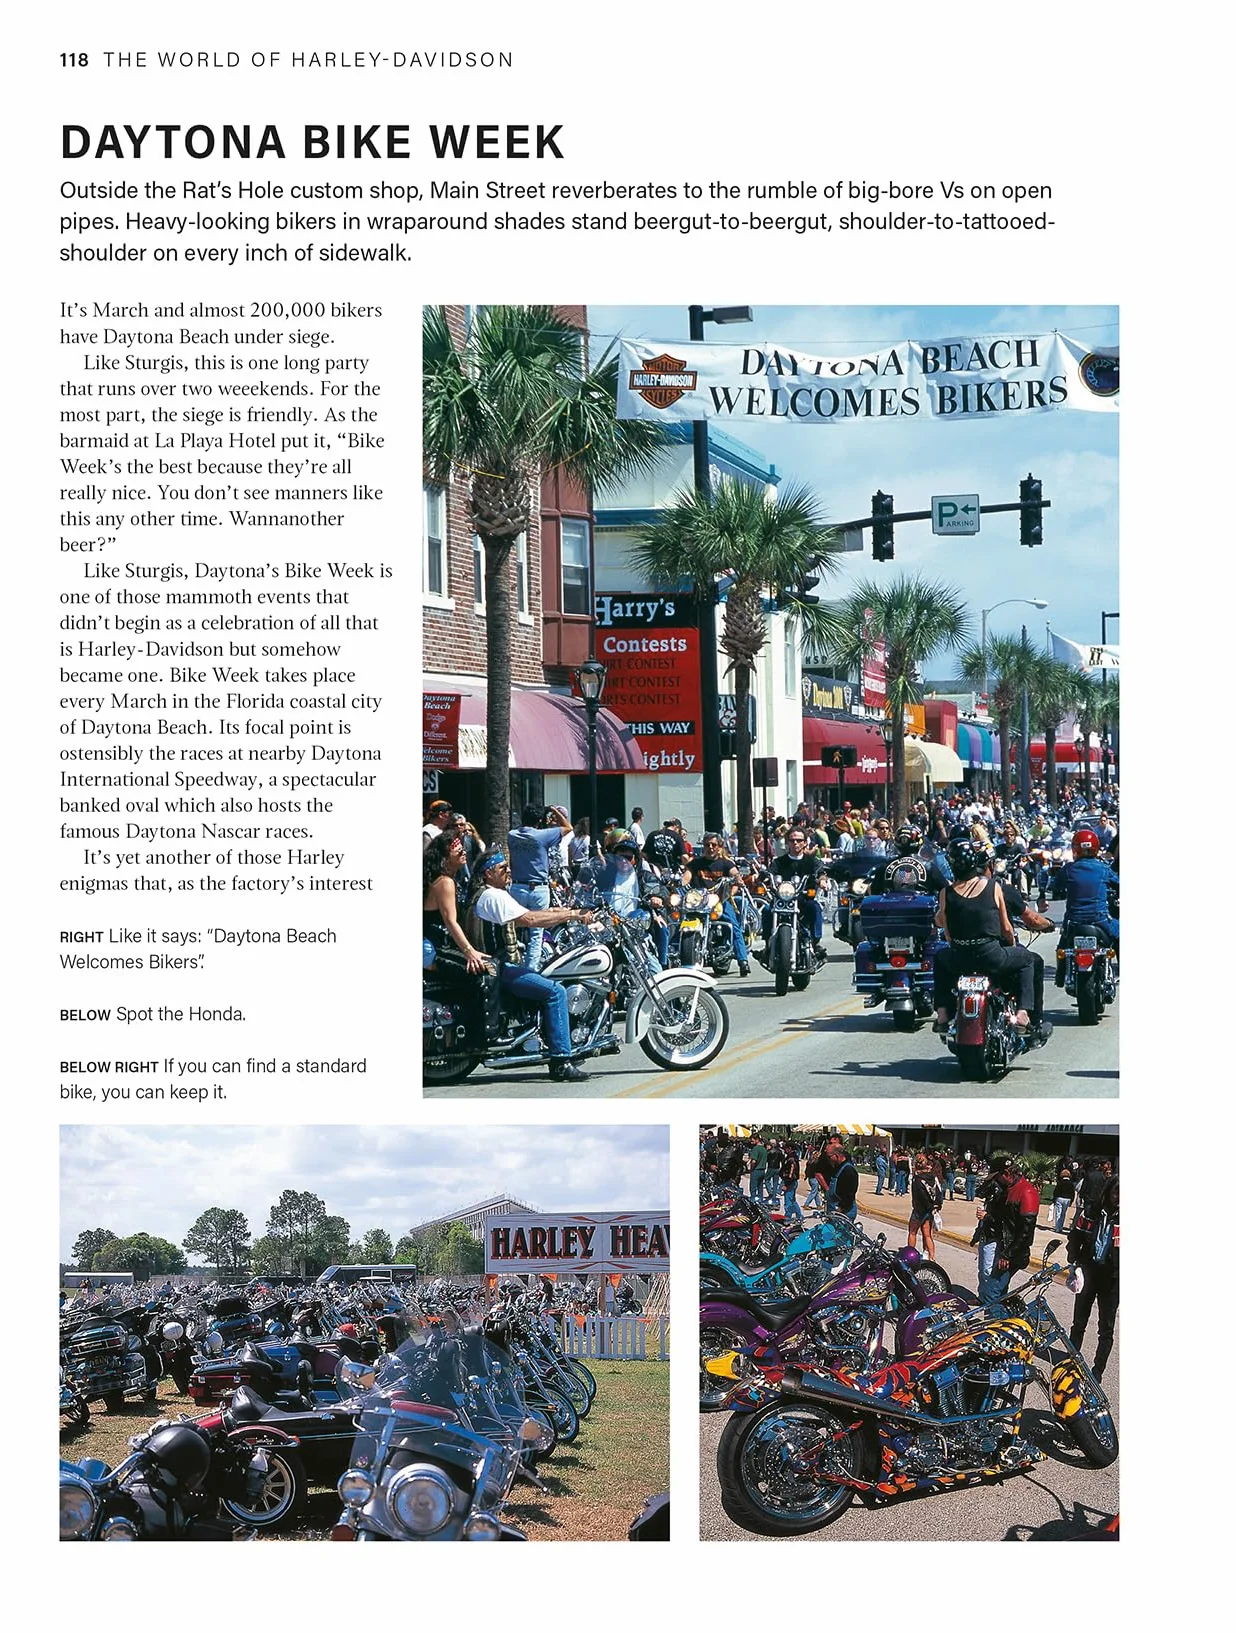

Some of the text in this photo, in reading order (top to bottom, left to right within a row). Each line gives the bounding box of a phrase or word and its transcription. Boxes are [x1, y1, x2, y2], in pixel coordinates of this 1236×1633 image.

[59, 51, 512, 68] 118 THE WORLD OF HARLEY-DAVIDSON
[62, 124, 565, 160] DAYTONA BIKE WEEK
[60, 180, 139, 199] Outside
[143, 180, 177, 199] the
[238, 180, 284, 199] Hole
[290, 181, 363, 199] custom
[369, 180, 424, 204] shop,
[430, 180, 479, 199] Main
[486, 180, 546, 199] Street
[552, 180, 678, 199] reverberates
[682, 181, 703, 199] to
[708, 180, 741, 199] the
[747, 180, 818, 199] rumble
[823, 180, 844, 199] of
[848, 180, 934, 204] big-bore
[939, 180, 965, 199] Vs
[970, 185, 996, 199] on
[1001, 185, 1052, 204] open
[59, 242, 412, 266] shoulder on every inch of sidewalk.
[60, 328, 335, 349] have Daytona Beach under siege.
[741, 338, 1040, 376] DAYTONA BEACH
[633, 374, 694, 387] HARLEY-DAVIDSON
[708, 375, 1069, 417] WELCOMES BIKERS
[603, 636, 688, 653] Contests
[627, 658, 675, 670] CONTEST
[629, 676, 681, 688] CONTEST
[630, 693, 680, 705] CONTEST
[660, 722, 690, 734] WAY
[59, 744, 382, 765] ostensibly the races at nearby Daytona
[423, 747, 453, 755] elcome
[643, 749, 696, 771] ightly
[60, 931, 105, 944] RIGHT
[109, 927, 142, 944] Like
[147, 927, 157, 944] it
[161, 931, 202, 947] says:
[287, 927, 337, 944] Beach
[60, 1005, 246, 1025] BELOW Spot the Honda.
[60, 1057, 367, 1077] BELOW RIGHT If you can find a standard
[60, 1083, 227, 1103] bike, you can keep it.
[490, 1226, 596, 1260] HARLEY
